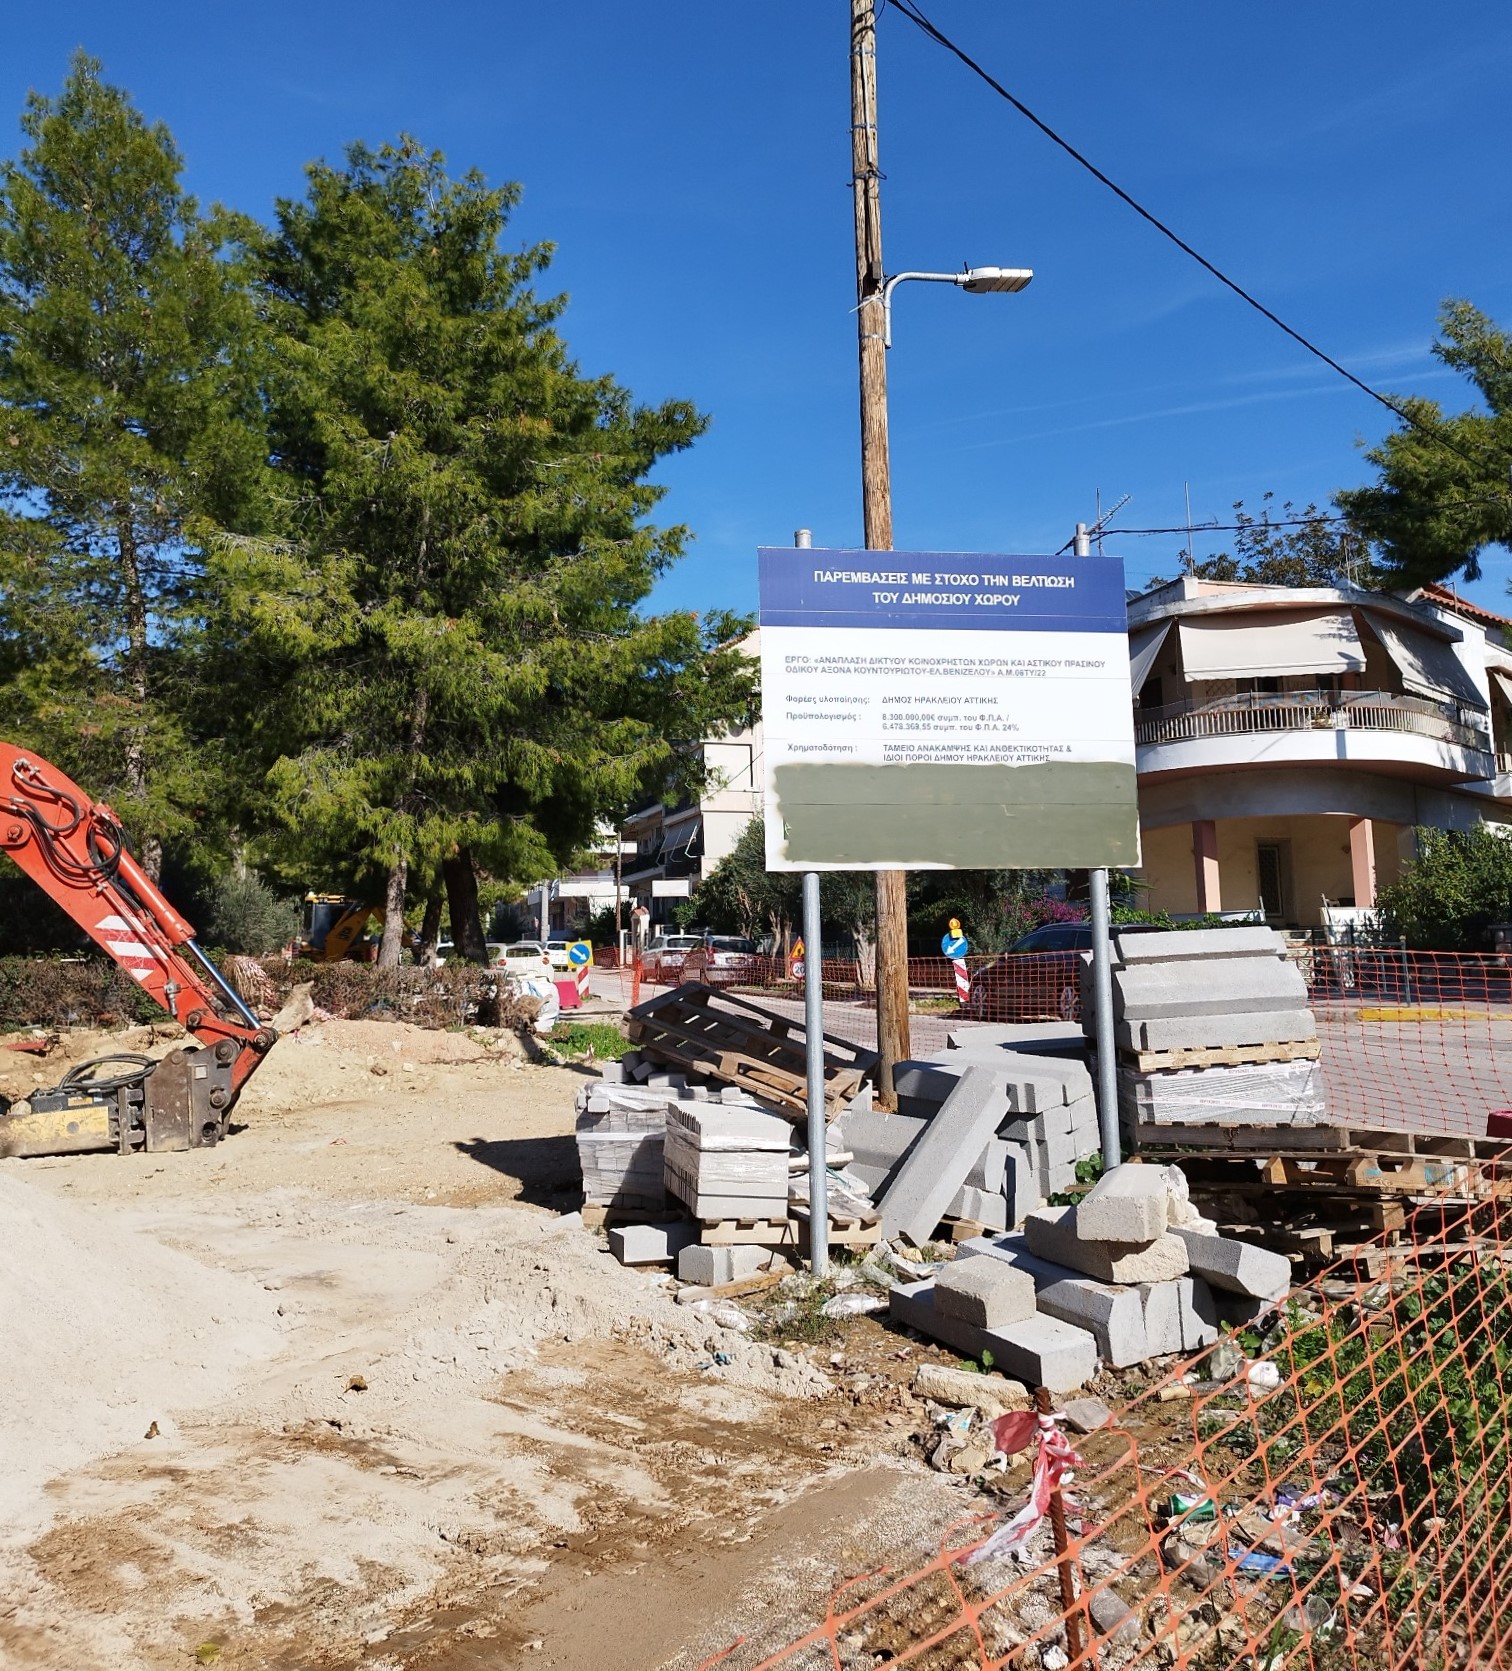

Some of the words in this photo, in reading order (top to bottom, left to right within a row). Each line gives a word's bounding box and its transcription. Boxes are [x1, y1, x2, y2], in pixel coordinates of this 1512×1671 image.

[814, 570, 909, 585] ΠΑΡΕΜΒΑΣΕΙΣ
[911, 572, 932, 585] ΜΕ
[934, 573, 979, 586] ΣΤΟΧΟ
[981, 574, 1009, 587] ΤΗΝ
[1012, 575, 1075, 588] ΒΕΛΤΙΩΣΗ
[872, 592, 900, 604] ΤΟΥ
[901, 592, 972, 605] ΔΗΜΟΣΙΟΥ
[974, 593, 1021, 606] ΧΩΡΟΥ
[785, 655, 811, 664] ΕΡΓΟ:
[814, 656, 868, 665] «ΑΝΑΠΛΑΣΗ
[868, 657, 906, 665] ΔΙΚΤΥΟΥ
[908, 657, 976, 666] ΚΟΙΝΟΧΡΗΣΤΩΝ
[978, 658, 1009, 667] ΧΩΡΩΝ
[1010, 659, 1025, 667] ΚΑΙ
[1026, 659, 1062, 668] ΑΣΤΙΚΟΥ
[1064, 660, 1106, 668] ΠΡΑΣΙΝΟΥ
[785, 665, 819, 674] ΟΔΙΚΟΥ
[820, 666, 851, 674] ΑΞΟΝΑ
[785, 694, 817, 704] Φορέας
[881, 696, 912, 704] ΔΗΜΟΣ
[914, 696, 962, 704] ΗΡΑΚΛΕΙΟΥ
[963, 697, 999, 705] ΑΤΤΙΚΗΣ
[937, 715, 962, 723] συμπ.
[933, 724, 958, 732] συμπ.
[787, 743, 853, 753] Χρηματοδότηση
[883, 744, 915, 752] ΤΑΜΕΙΟ
[916, 744, 972, 752] ΑΝΑΚΑΜΨΗΣ
[973, 744, 988, 753] ΚΑΙ
[989, 744, 1064, 753] ΑΝΘΕΚΤΙΚΟΤΗΤΑΣ
[1065, 745, 1072, 753] &
[934, 754, 965, 762] ΔΗΜΟΥ
[966, 754, 1014, 762] ΗΡΑΚΛΕΙΟΥ
[1016, 754, 1050, 762] ΑΤΤΙΚΗΣ
